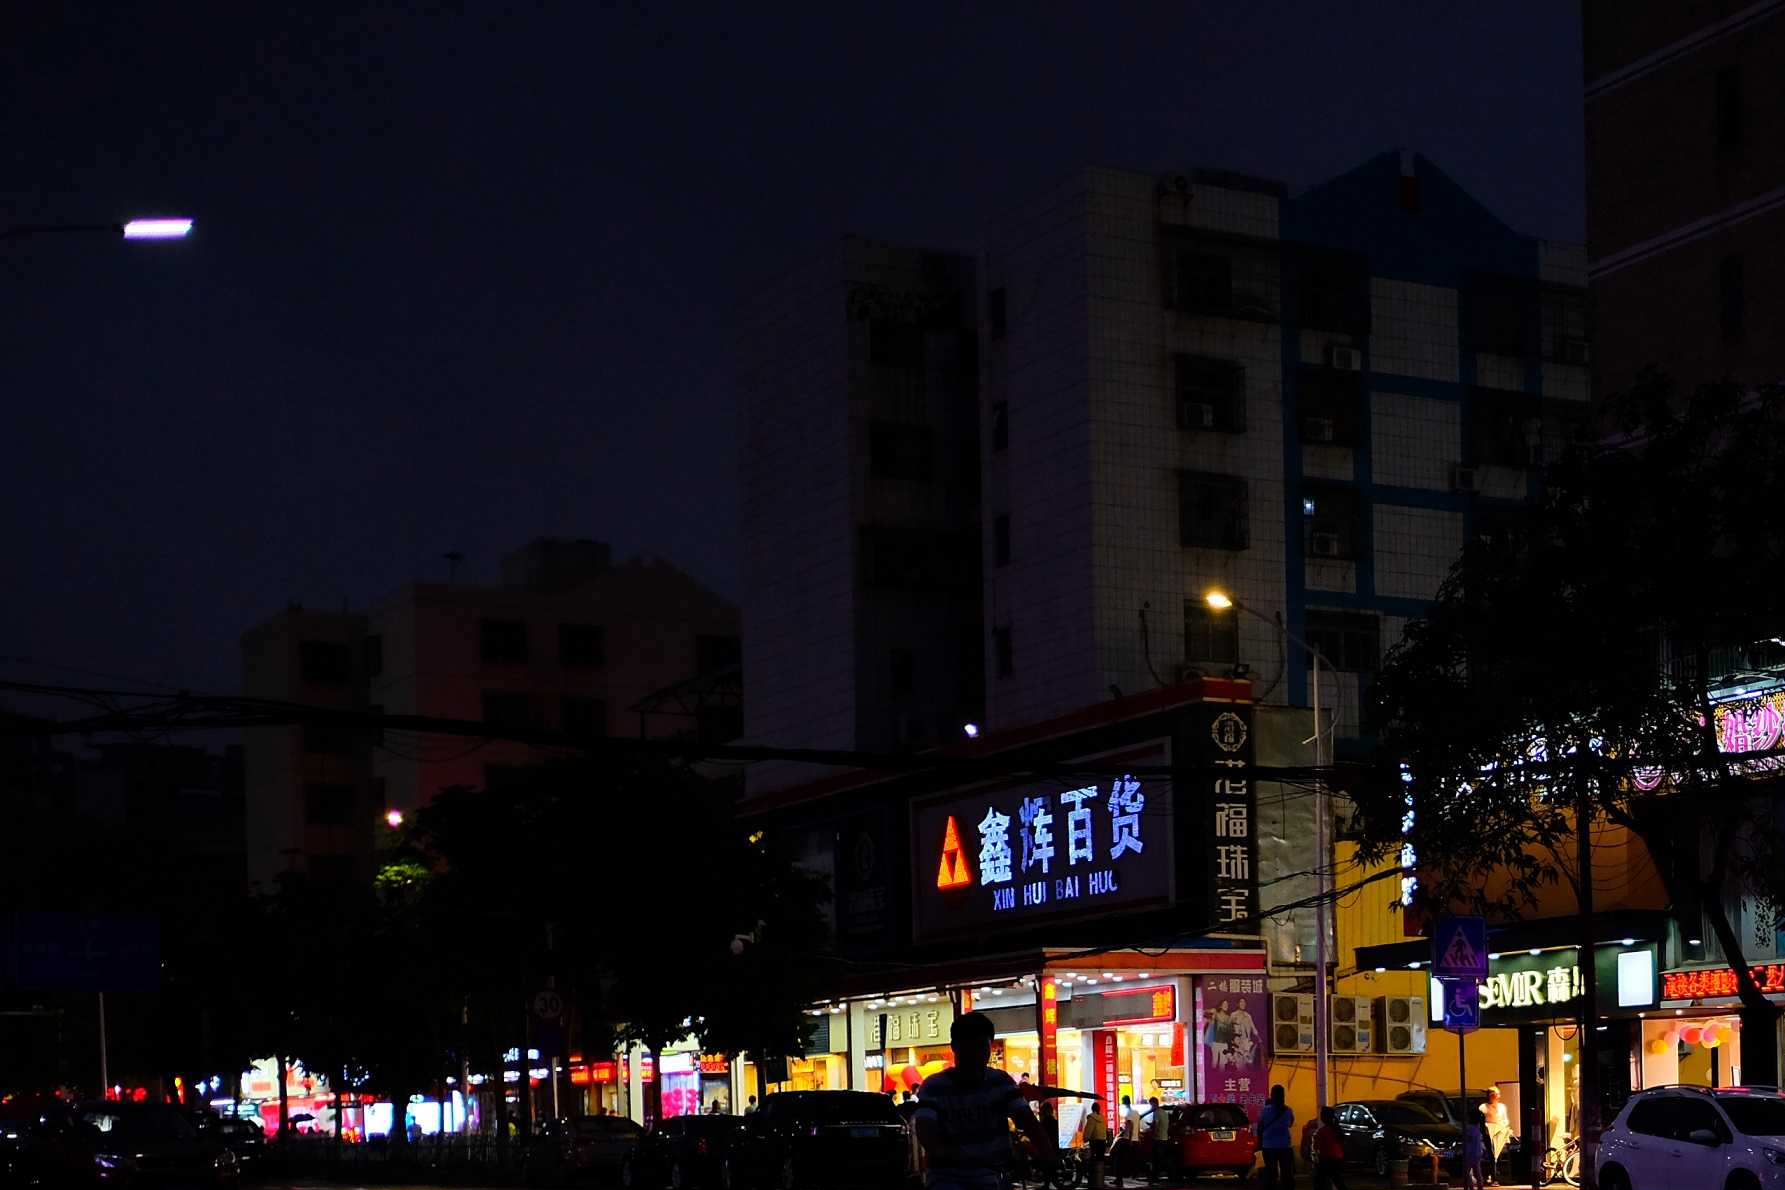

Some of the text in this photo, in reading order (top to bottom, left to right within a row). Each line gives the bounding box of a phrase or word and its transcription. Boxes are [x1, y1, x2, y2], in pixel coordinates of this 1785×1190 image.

[977, 774, 1145, 887] 鑫辉百货
[993, 886, 1016, 911] XIN
[1023, 881, 1048, 905] HUI
[1055, 875, 1080, 900] BAI
[539, 997, 559, 1013] 30
[1224, 1078, 1251, 1092] 主营
[957, 1105, 1005, 1120] MUSIC
